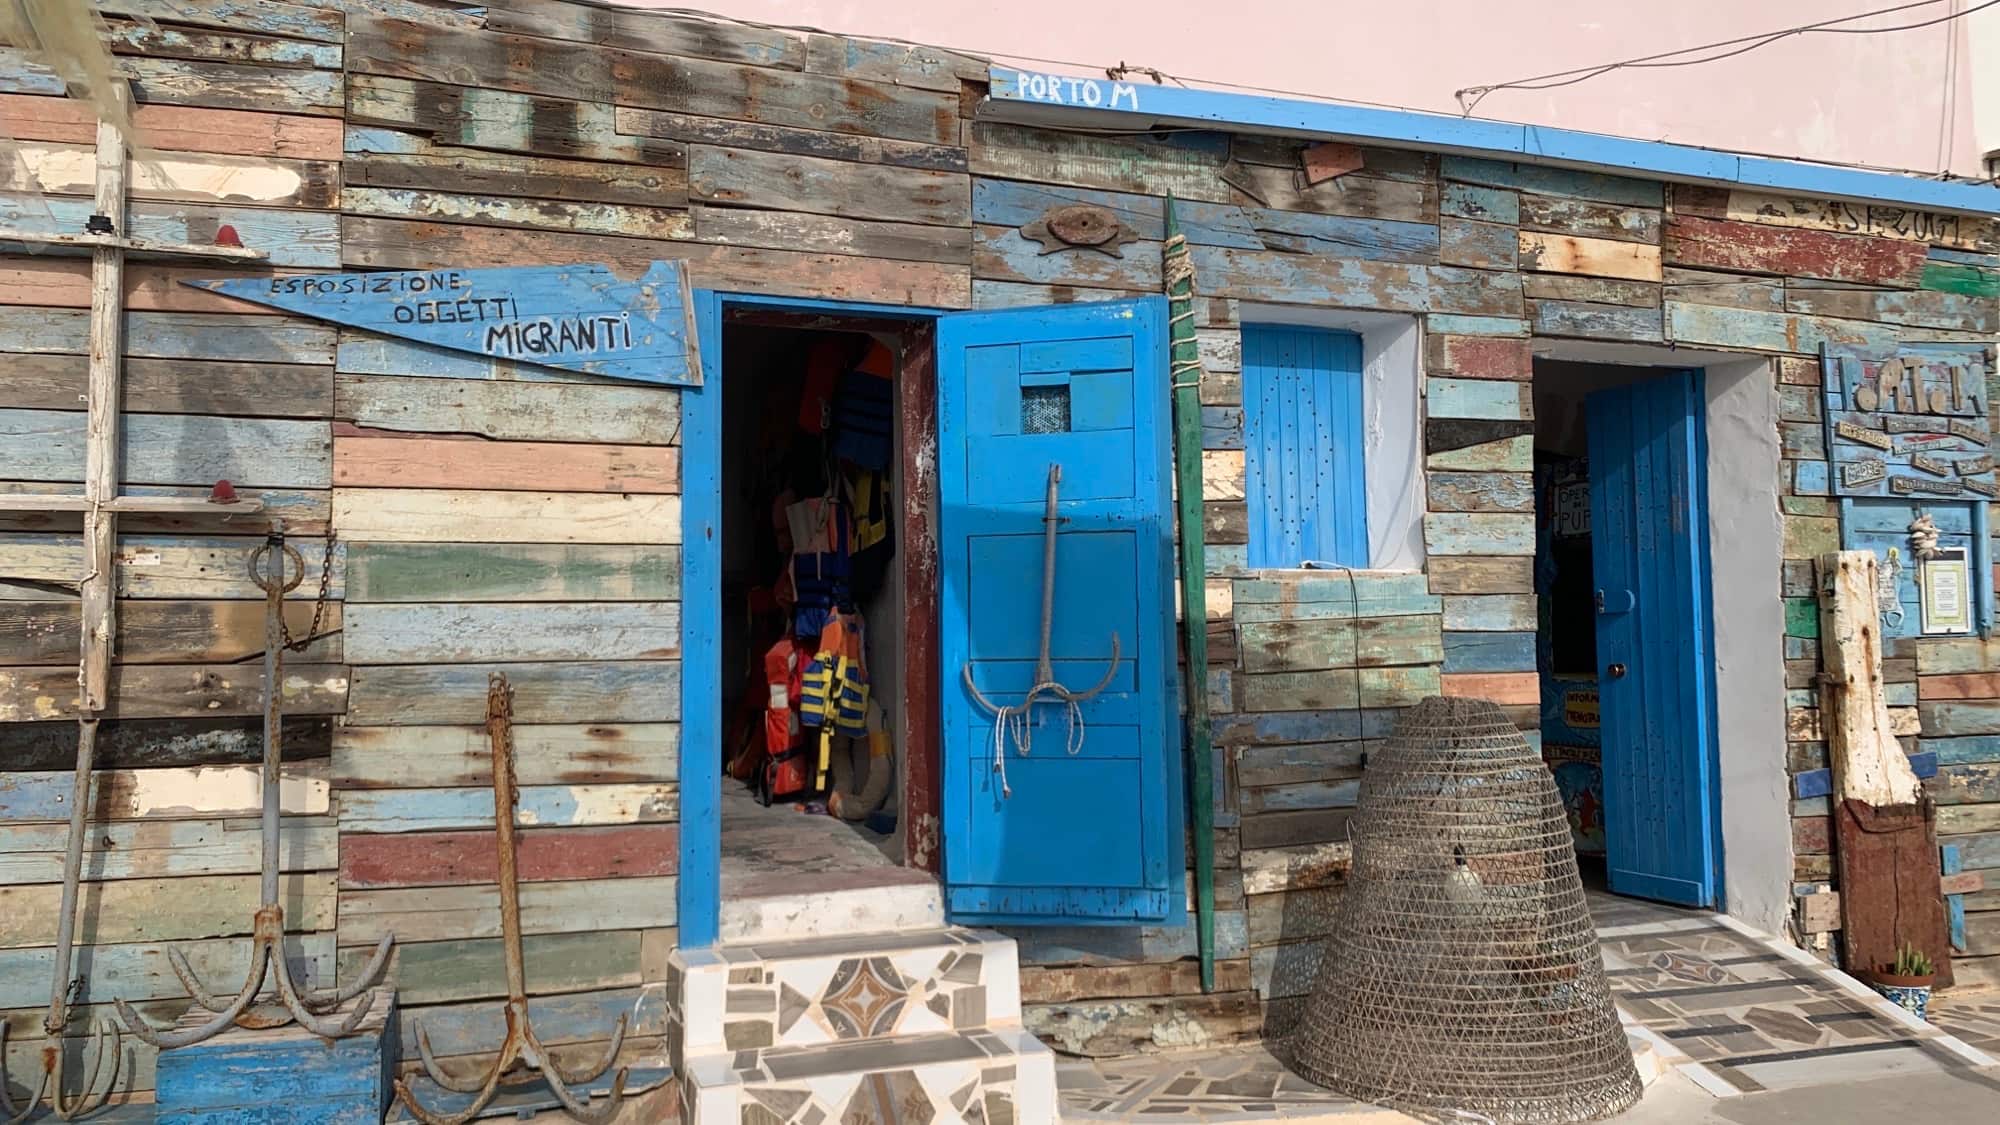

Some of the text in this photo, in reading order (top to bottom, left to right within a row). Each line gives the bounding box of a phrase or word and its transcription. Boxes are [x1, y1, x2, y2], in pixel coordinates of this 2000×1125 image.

[1017, 72, 1139, 112] PORTO M
[394, 292, 519, 324] OGGETTI
[485, 312, 632, 354] MIGRANTI
[1560, 487, 1592, 504] OPER
